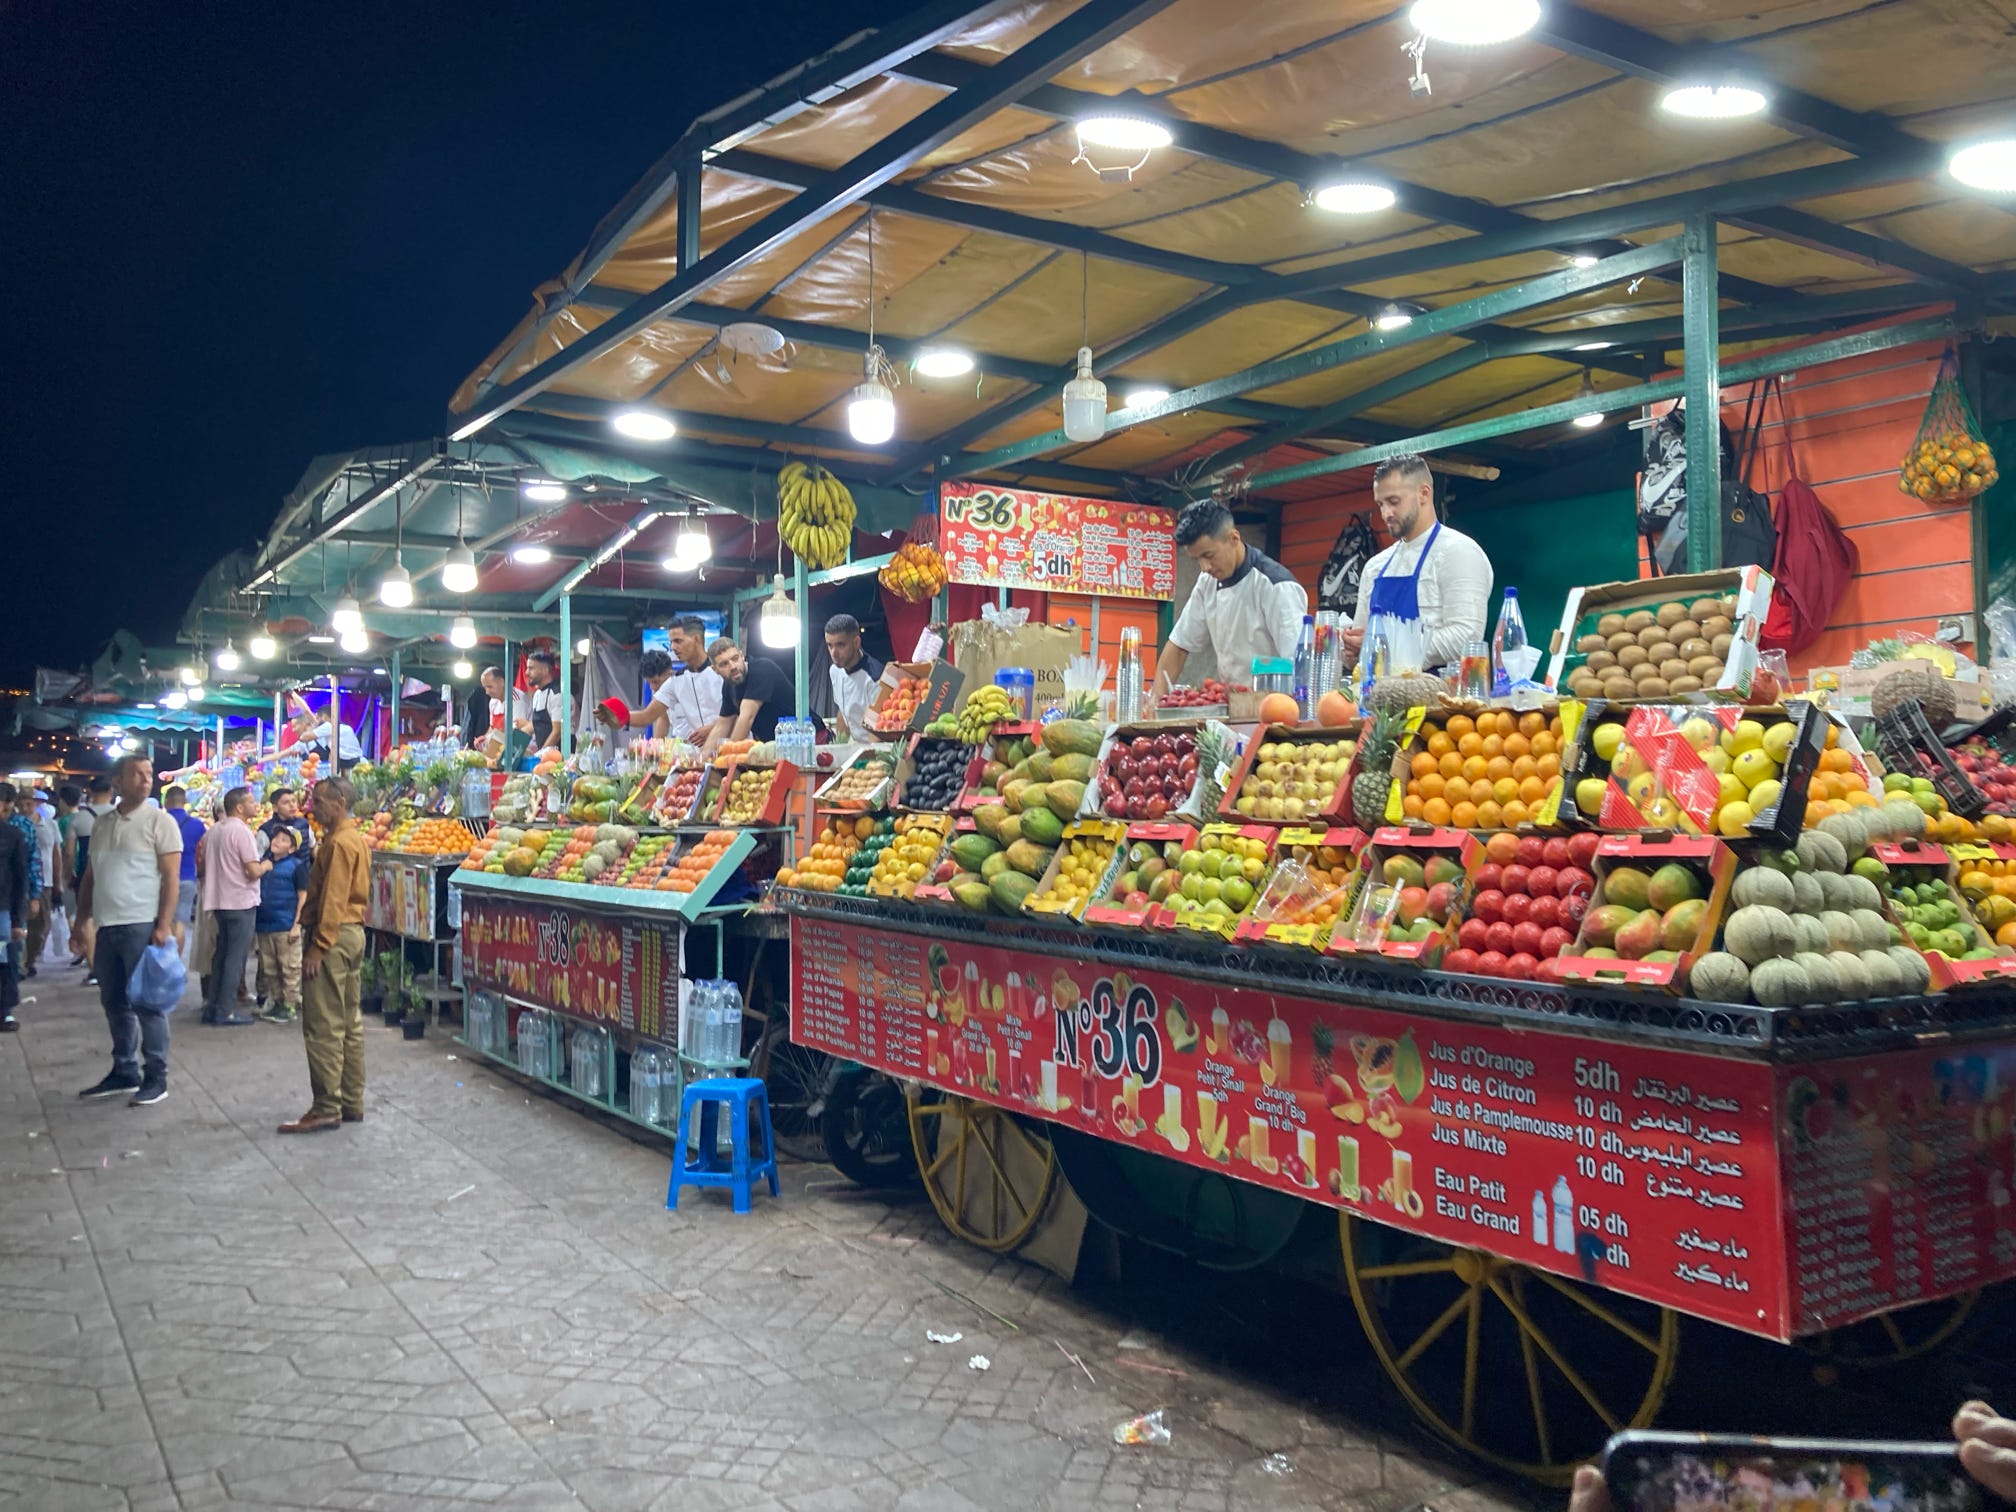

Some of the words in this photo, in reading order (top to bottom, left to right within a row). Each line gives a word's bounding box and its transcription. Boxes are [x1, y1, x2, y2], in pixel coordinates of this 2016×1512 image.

[947, 492, 1015, 530] N°36
[1030, 540, 1043, 551] Jus
[1033, 549, 1071, 580] 5dh
[1053, 977, 1161, 1088] N°36
[1204, 1058, 1234, 1079] Orange
[1429, 1040, 1456, 1063] Jus
[1461, 1045, 1535, 1079] d'Orange
[1574, 1056, 1620, 1093] 5dh
[1197, 1070, 1215, 1086] Petit
[1222, 1076, 1245, 1093] Small
[1262, 1083, 1296, 1104] Orange
[1632, 1077, 1691, 1106] البرتقال
[1213, 1088, 1228, 1103] 5dh
[1429, 1067, 1457, 1090] Jus
[1461, 1074, 1481, 1095] de
[1485, 1077, 1537, 1105] Citron
[1574, 1095, 1594, 1118] 10
[1600, 1100, 1623, 1124] dh
[1694, 1093, 1741, 1112] عصير
[1255, 1097, 1283, 1116] Grand
[1290, 1105, 1306, 1124] Big
[1630, 1109, 1692, 1134] الحامض
[1269, 1115, 1280, 1129] 10
[1281, 1118, 1294, 1133] dh
[1430, 1094, 1453, 1117] Jus
[1455, 1100, 1471, 1121] de
[1473, 1102, 1574, 1142] Pamplemousse
[1575, 1125, 1595, 1149] 10
[1600, 1130, 1624, 1155] dh
[1694, 1124, 1742, 1145] عصير
[1431, 1122, 1460, 1145] Jus
[1463, 1127, 1507, 1156] Mixte
[1576, 1155, 1597, 1179] 10
[1601, 1161, 1625, 1186] dh
[1694, 1156, 1743, 1177] عصير
[1646, 1173, 1694, 1198] متنوع
[1434, 1167, 1465, 1193] Eau
[1469, 1175, 1507, 1203] Patit
[1578, 1204, 1601, 1230] 05
[1604, 1212, 1629, 1238] dh
[1695, 1188, 1744, 1210] عصير
[1436, 1195, 1466, 1221] Eau
[1471, 1204, 1520, 1235] Grand
[1606, 1243, 1631, 1269] dh
[1674, 1228, 1721, 1252] صغير
[1722, 1237, 1748, 1259] ماء
[1673, 1262, 1722, 1285] كبير
[1724, 1270, 1749, 1292] ماء
